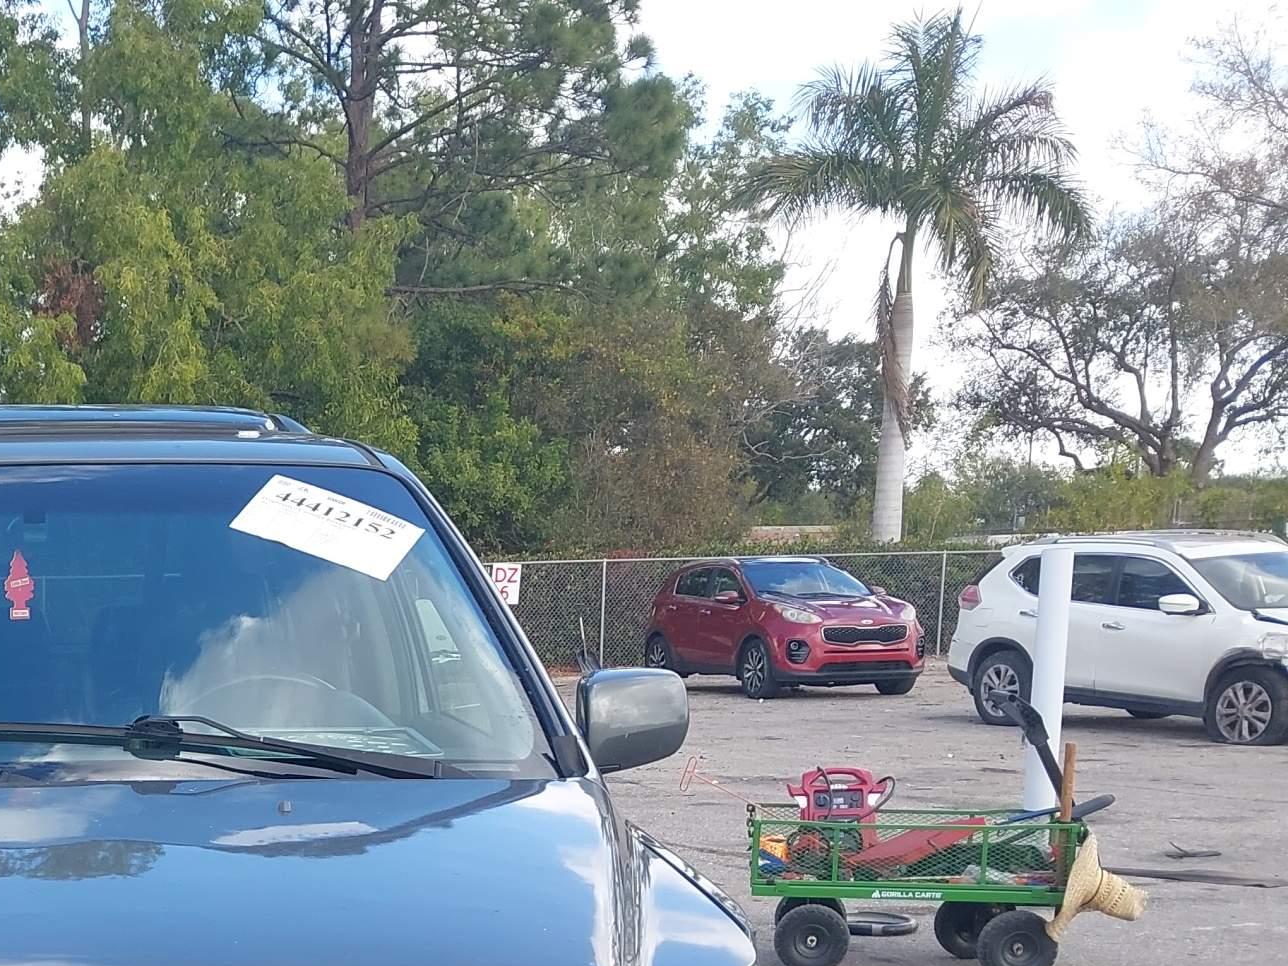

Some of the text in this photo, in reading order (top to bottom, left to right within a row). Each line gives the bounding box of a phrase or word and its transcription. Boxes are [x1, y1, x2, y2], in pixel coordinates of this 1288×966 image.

[275, 492, 396, 540] 44412152
[495, 568, 518, 583] DZ
[881, 890, 913, 898] GORILLA
